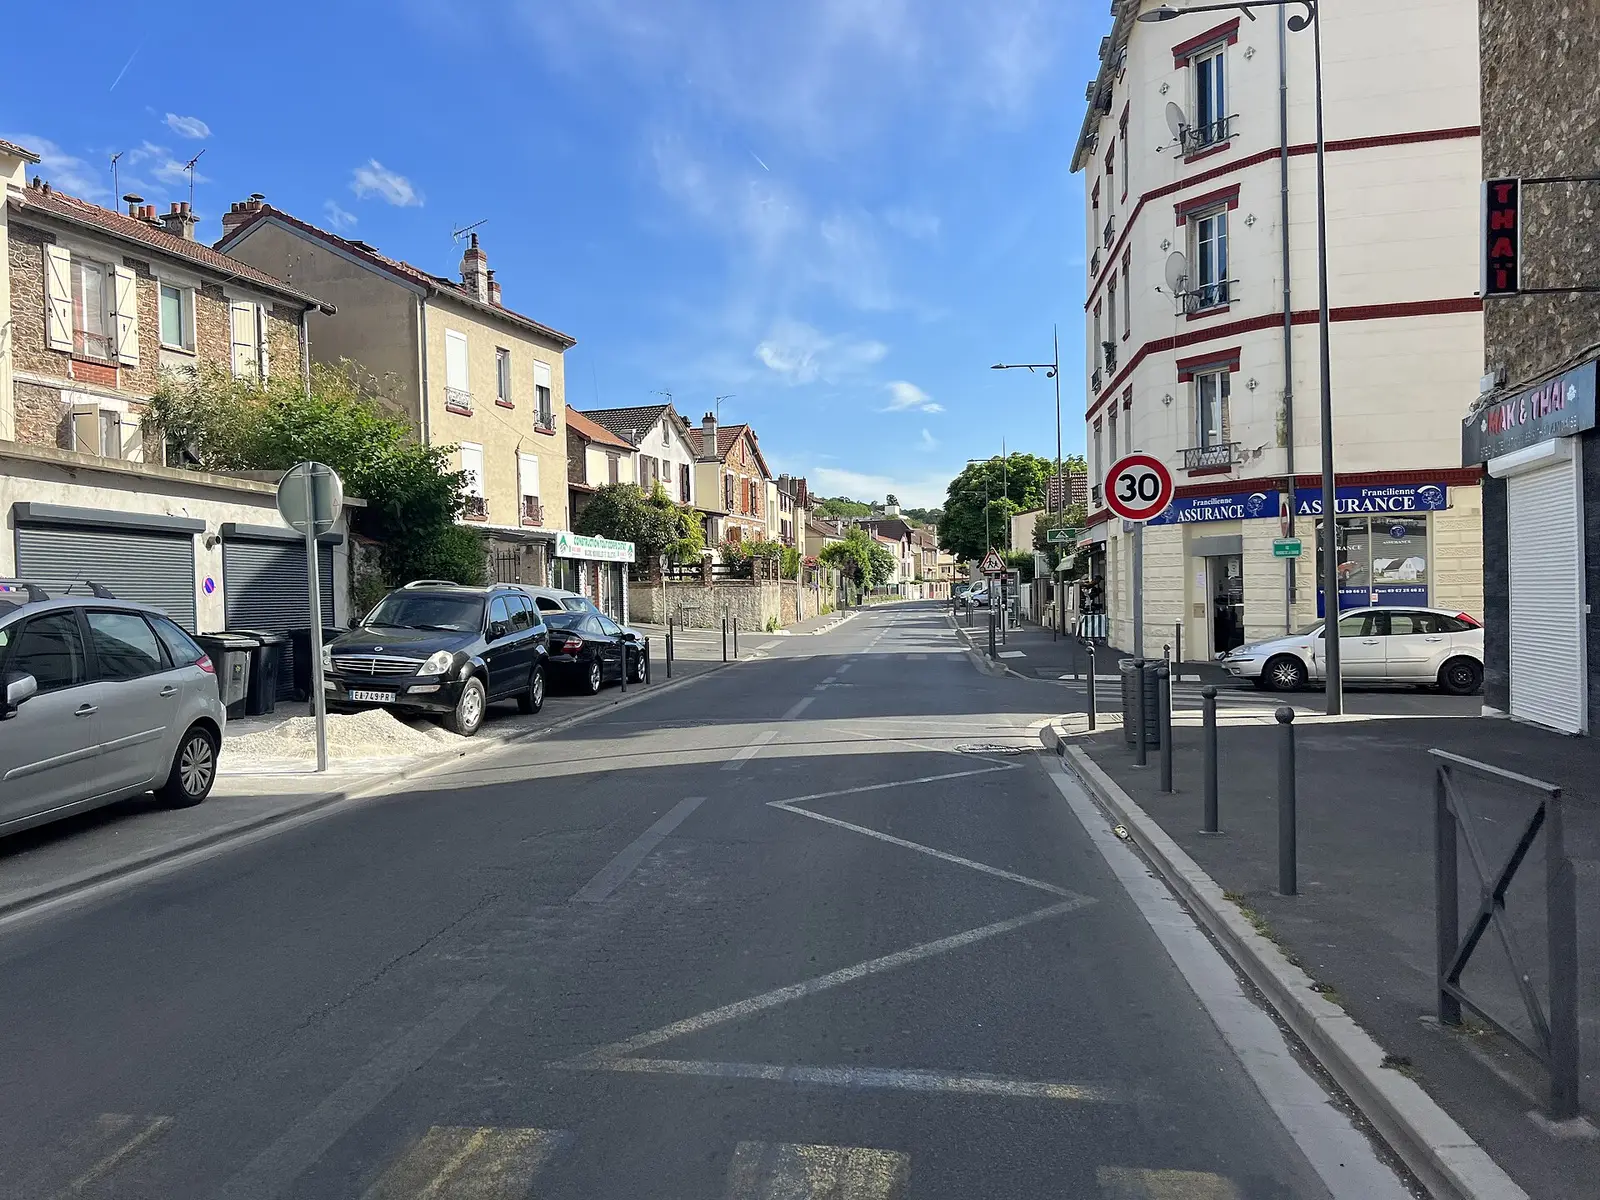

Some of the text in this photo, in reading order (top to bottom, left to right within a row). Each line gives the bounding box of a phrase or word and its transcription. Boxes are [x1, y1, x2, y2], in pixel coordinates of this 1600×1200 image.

[1488, 400, 1517, 436] MAK
[1117, 472, 1160, 502] 30
[1361, 487, 1415, 497] Francilienne
[1192, 498, 1232, 506] Francilienne
[1298, 496, 1416, 514] ASURANCE
[1177, 504, 1245, 522] ASSURANCE
[573, 536, 599, 548] CONSTRUCTION
